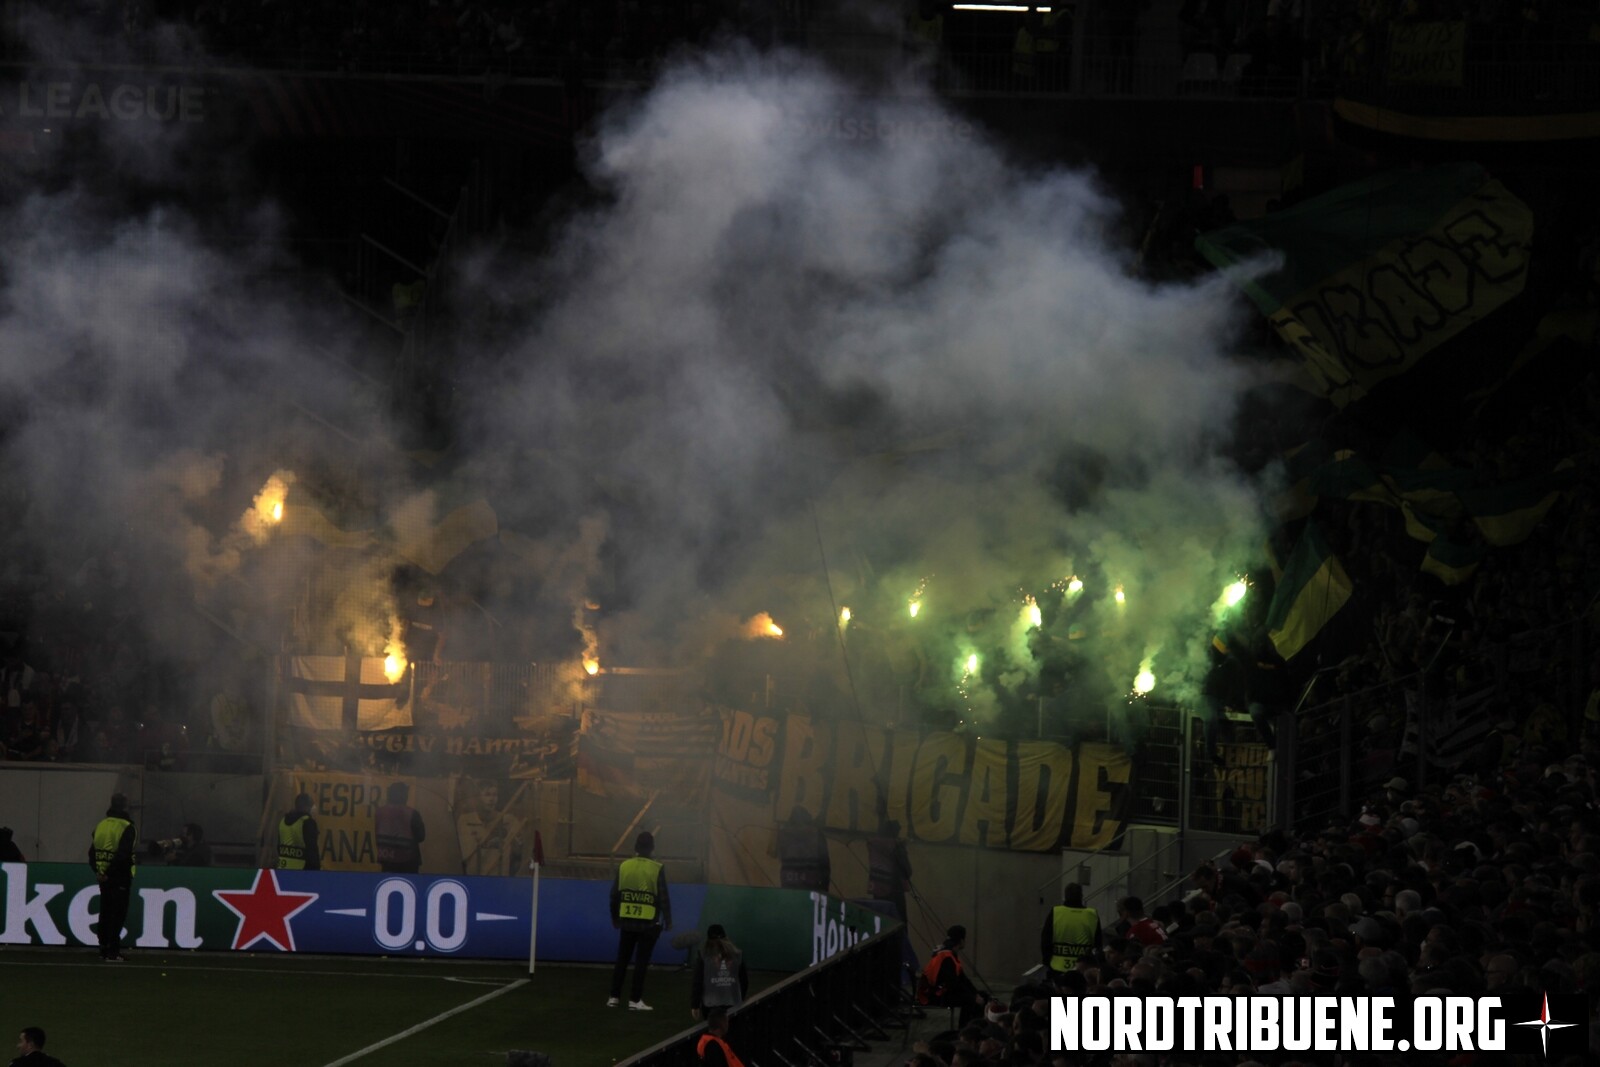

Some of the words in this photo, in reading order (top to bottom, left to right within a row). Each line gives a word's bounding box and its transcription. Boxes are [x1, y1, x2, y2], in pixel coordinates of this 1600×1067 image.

[19, 80, 205, 122] LEAGUE
[775, 714, 1133, 853] BRIGADE
[374, 877, 469, 951] 0.0
